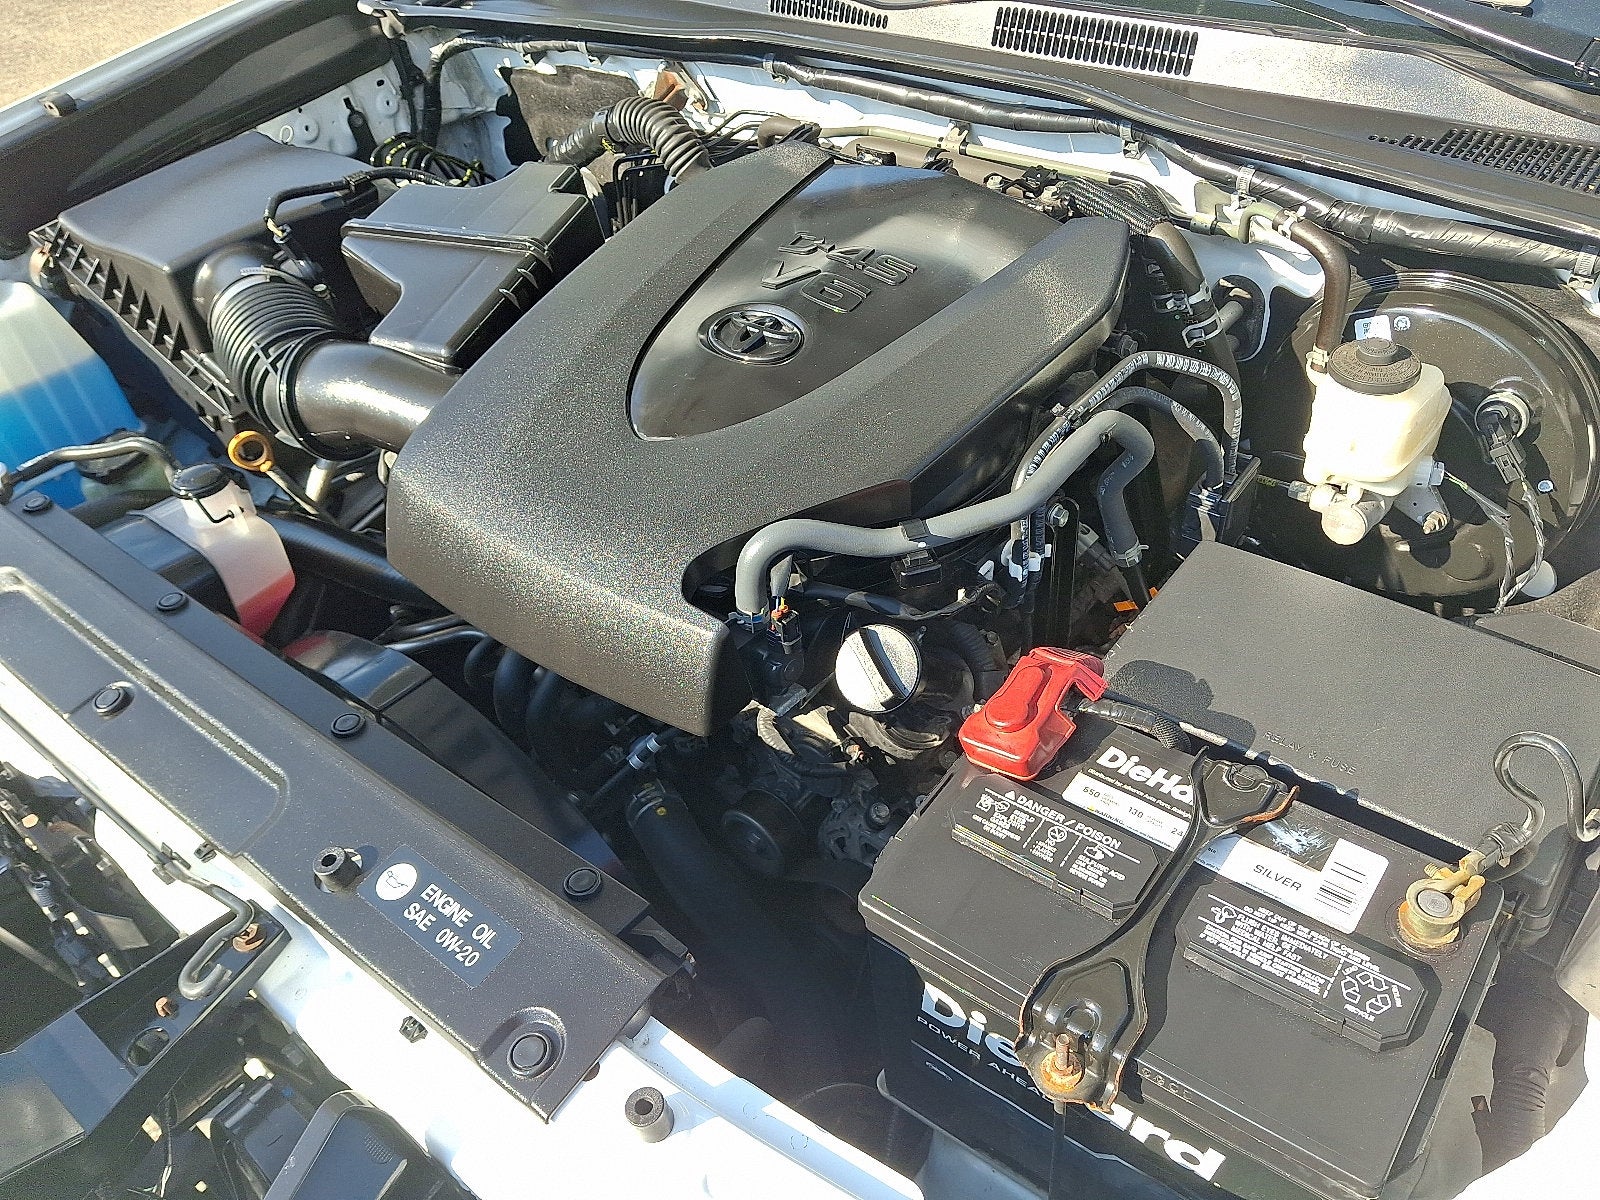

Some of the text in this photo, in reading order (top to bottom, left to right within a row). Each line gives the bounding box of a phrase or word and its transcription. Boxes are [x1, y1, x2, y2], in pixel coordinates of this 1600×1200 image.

[761, 259, 872, 314] V6
[1096, 745, 1194, 806] DieHa
[1262, 731, 1357, 775] RELAY & FUSE
[1016, 795, 1066, 823] DANGER
[1074, 822, 1122, 850] POISON
[1082, 786, 1101, 799] 650
[1128, 806, 1144, 820] 130
[1252, 864, 1303, 892] SILVER
[403, 902, 481, 967] SAE 0W-20
[420, 883, 497, 950] ENGINE OIL
[1236, 913, 1260, 928] FLUSH
[1261, 925, 1280, 937] EYES
[1281, 934, 1329, 961] IMMEDIATELY
[1231, 925, 1263, 944] MEDICAL
[1262, 940, 1282, 952] HELP
[1282, 950, 1302, 962] FAST
[1281, 942, 1297, 952] GET
[916, 1015, 981, 1061] POWER
[986, 1061, 1054, 1103] AHEA
